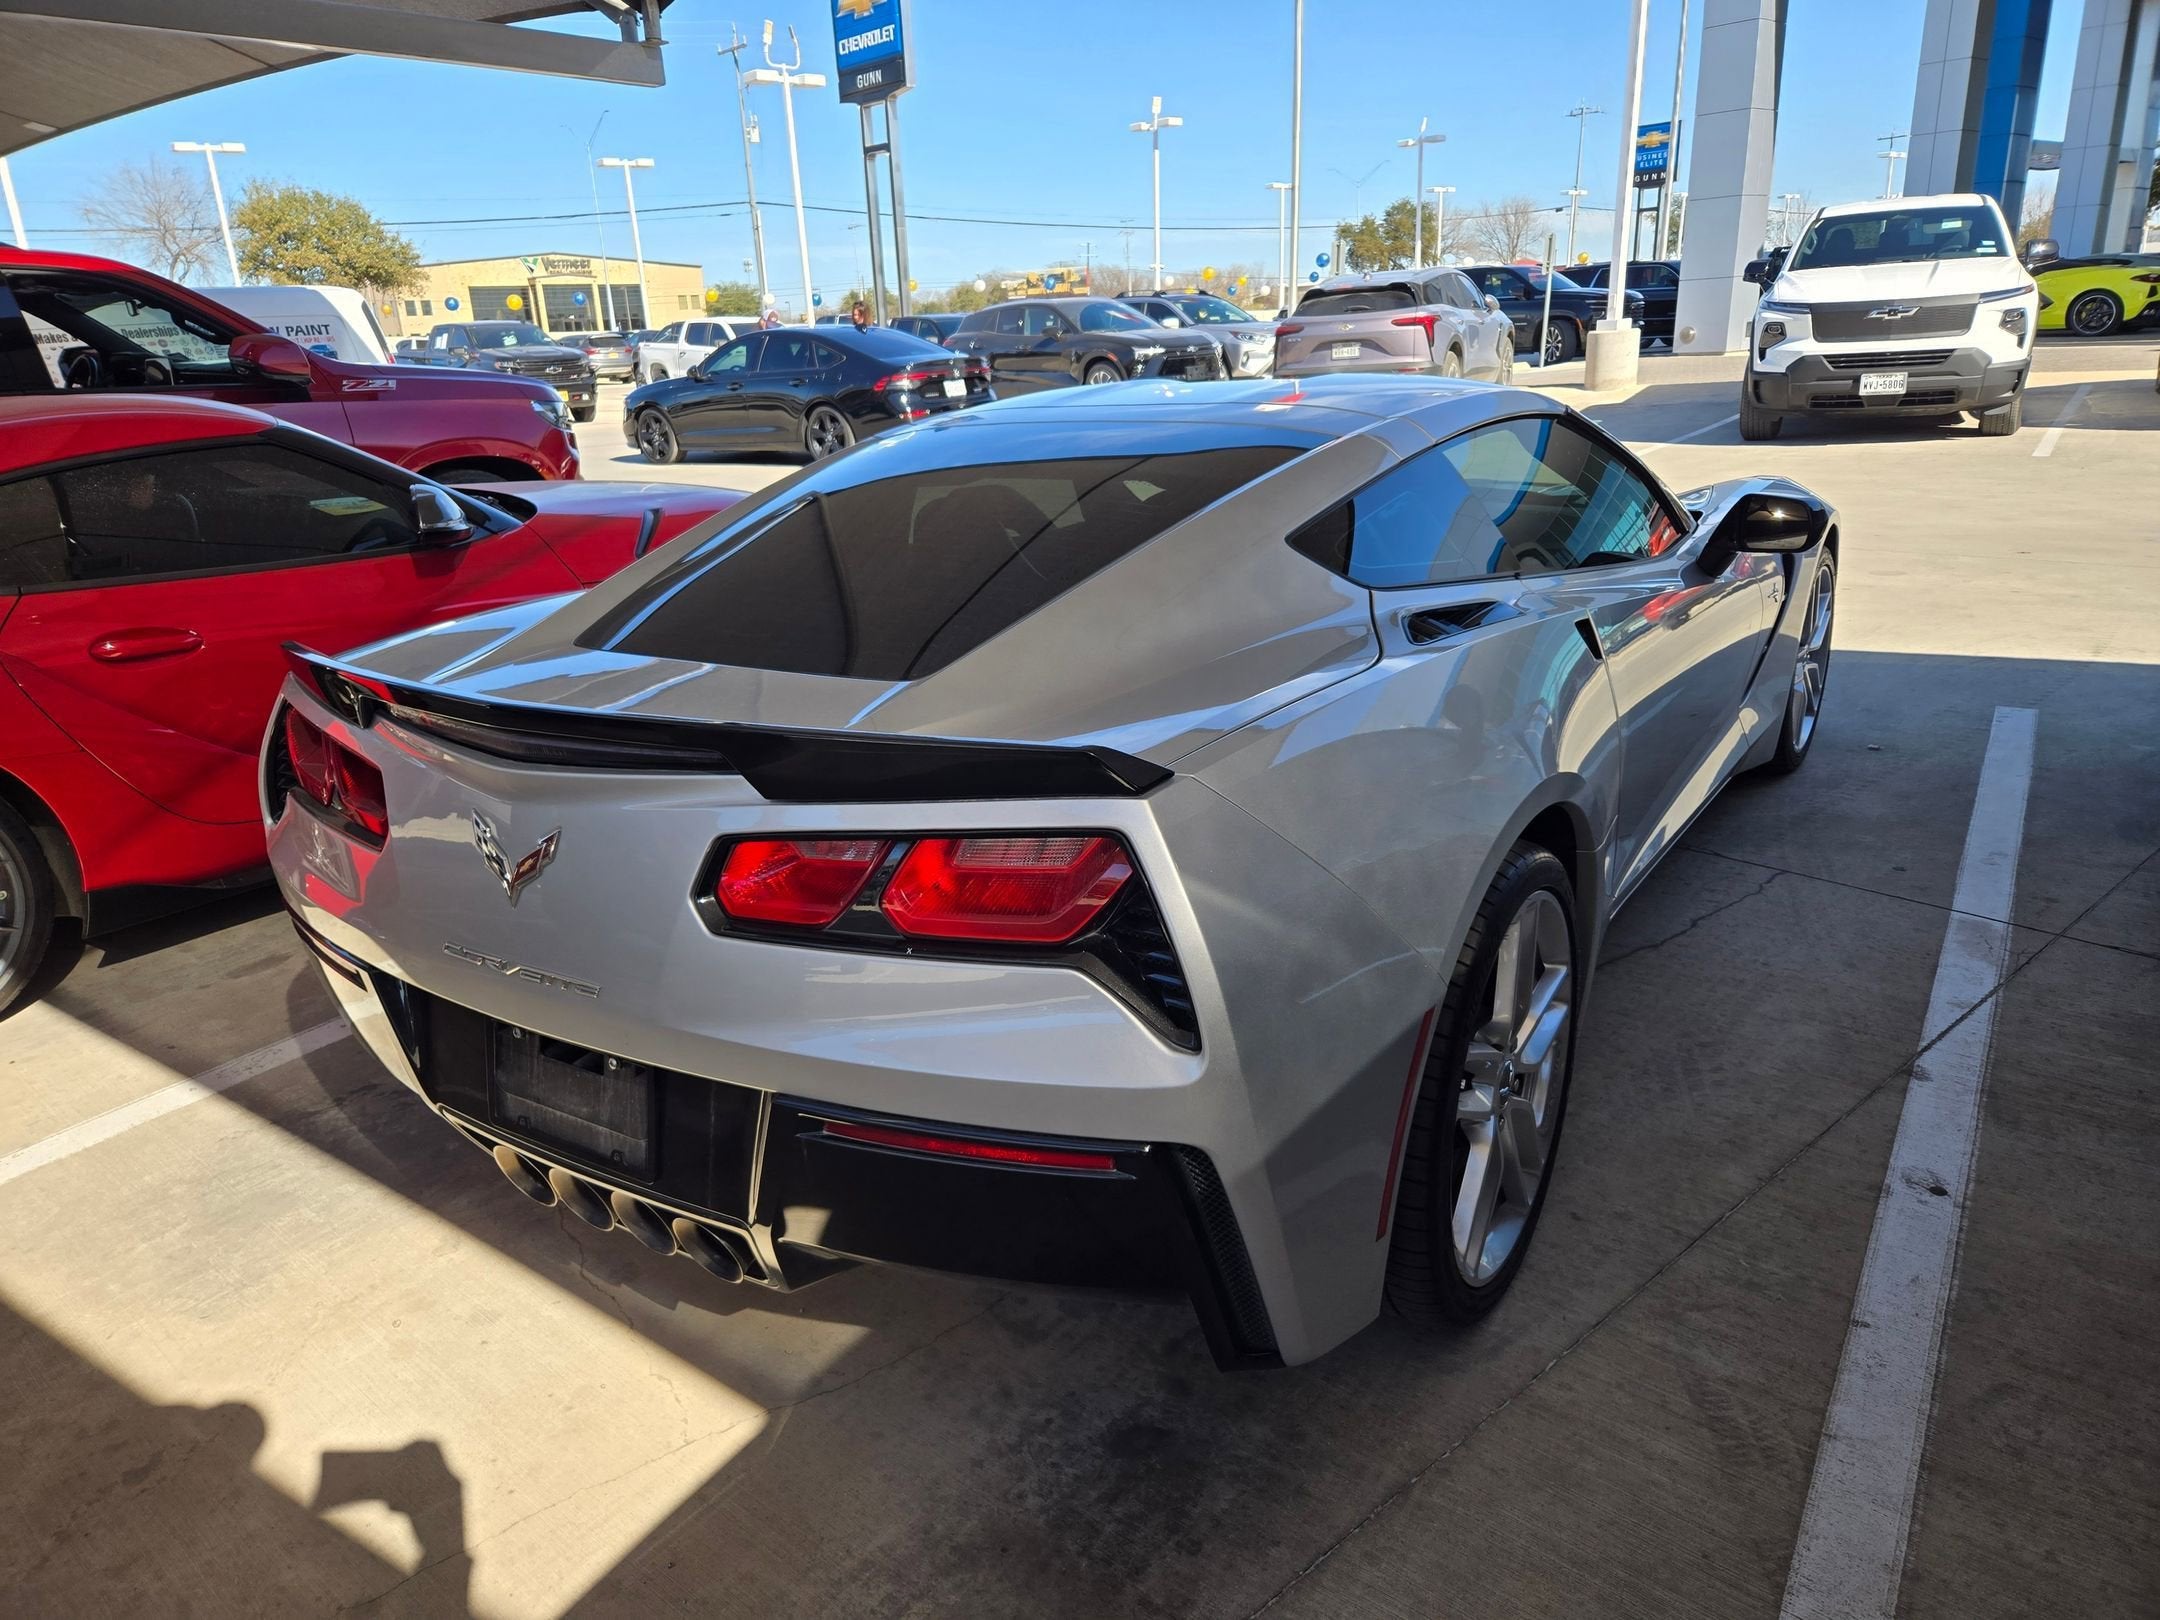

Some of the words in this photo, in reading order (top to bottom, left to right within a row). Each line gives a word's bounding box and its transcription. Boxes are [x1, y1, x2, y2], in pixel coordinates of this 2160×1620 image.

[838, 24, 895, 55] CHEVROLET
[857, 69, 882, 88] GUNN
[1637, 151, 1668, 161] USINES
[1640, 158, 1663, 168] ELITE
[1634, 172, 1666, 182] GUNN
[121, 325, 180, 339] Dealerships
[285, 324, 330, 337] PAINT
[34, 332, 69, 345] Makes
[442, 941, 601, 999] CORVETTE
